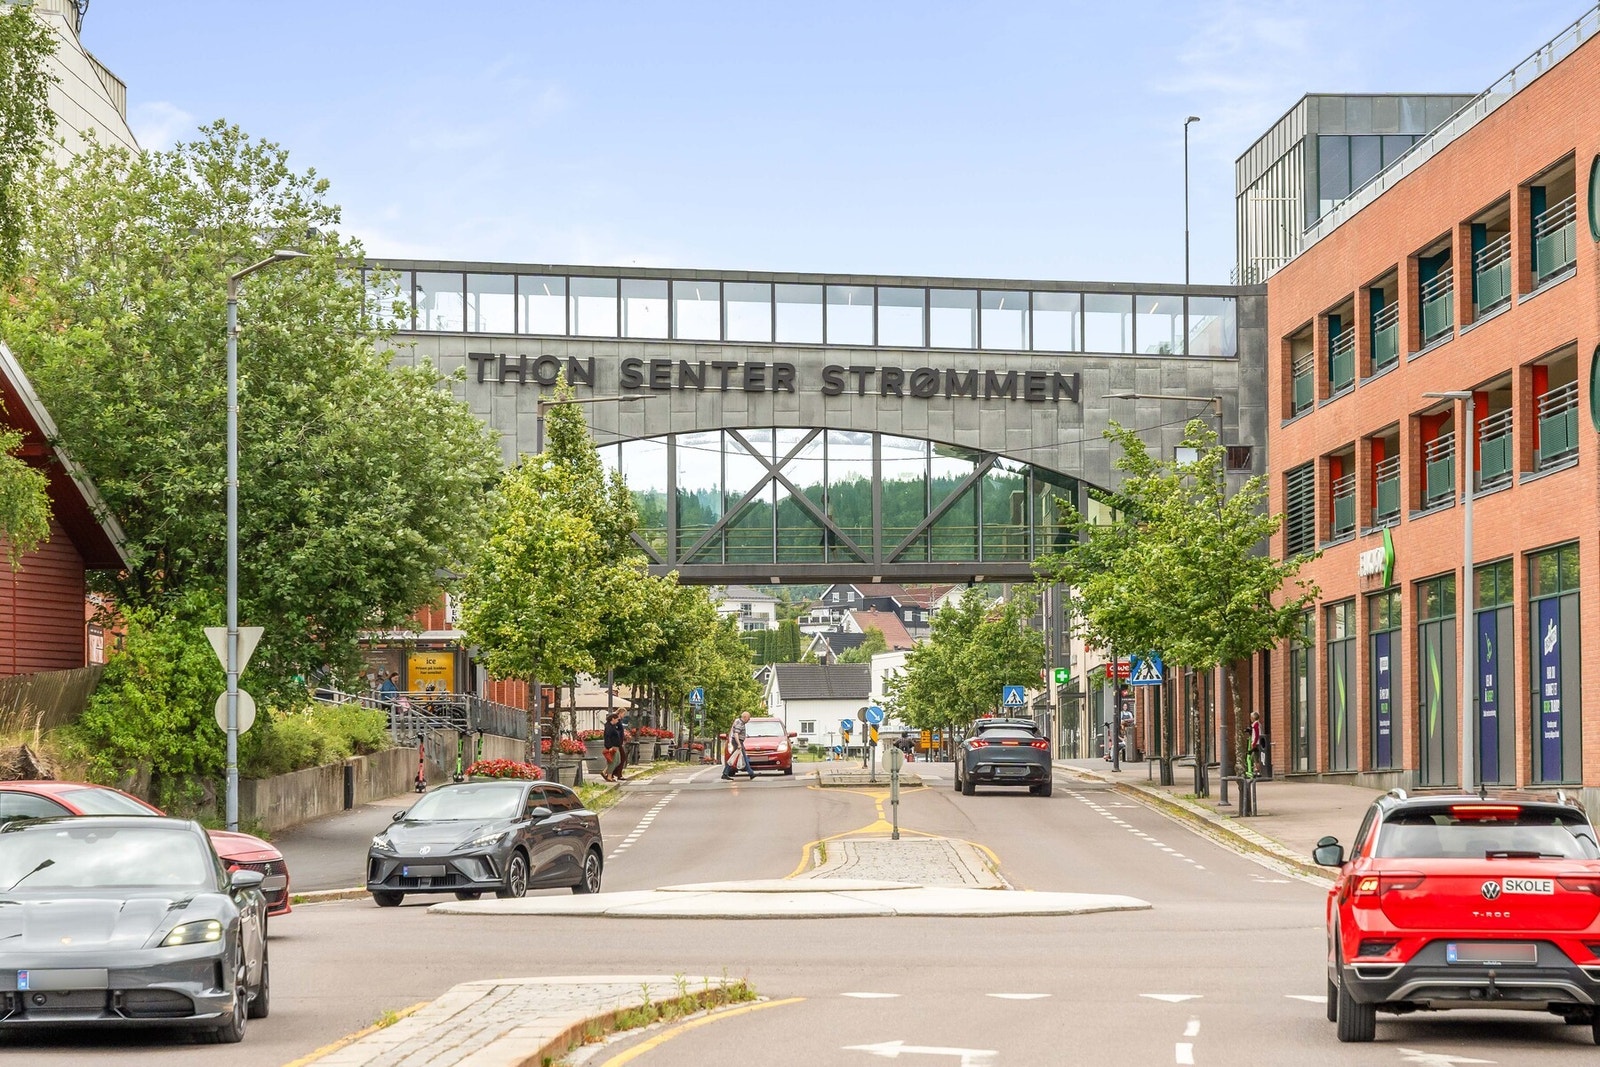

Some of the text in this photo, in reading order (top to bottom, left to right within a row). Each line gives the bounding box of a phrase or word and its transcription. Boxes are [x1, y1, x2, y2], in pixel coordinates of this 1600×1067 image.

[468, 352, 1080, 403] THON SENTER STRØMMEN
[426, 657, 437, 665] ice
[1505, 880, 1551, 892] SKOLE
